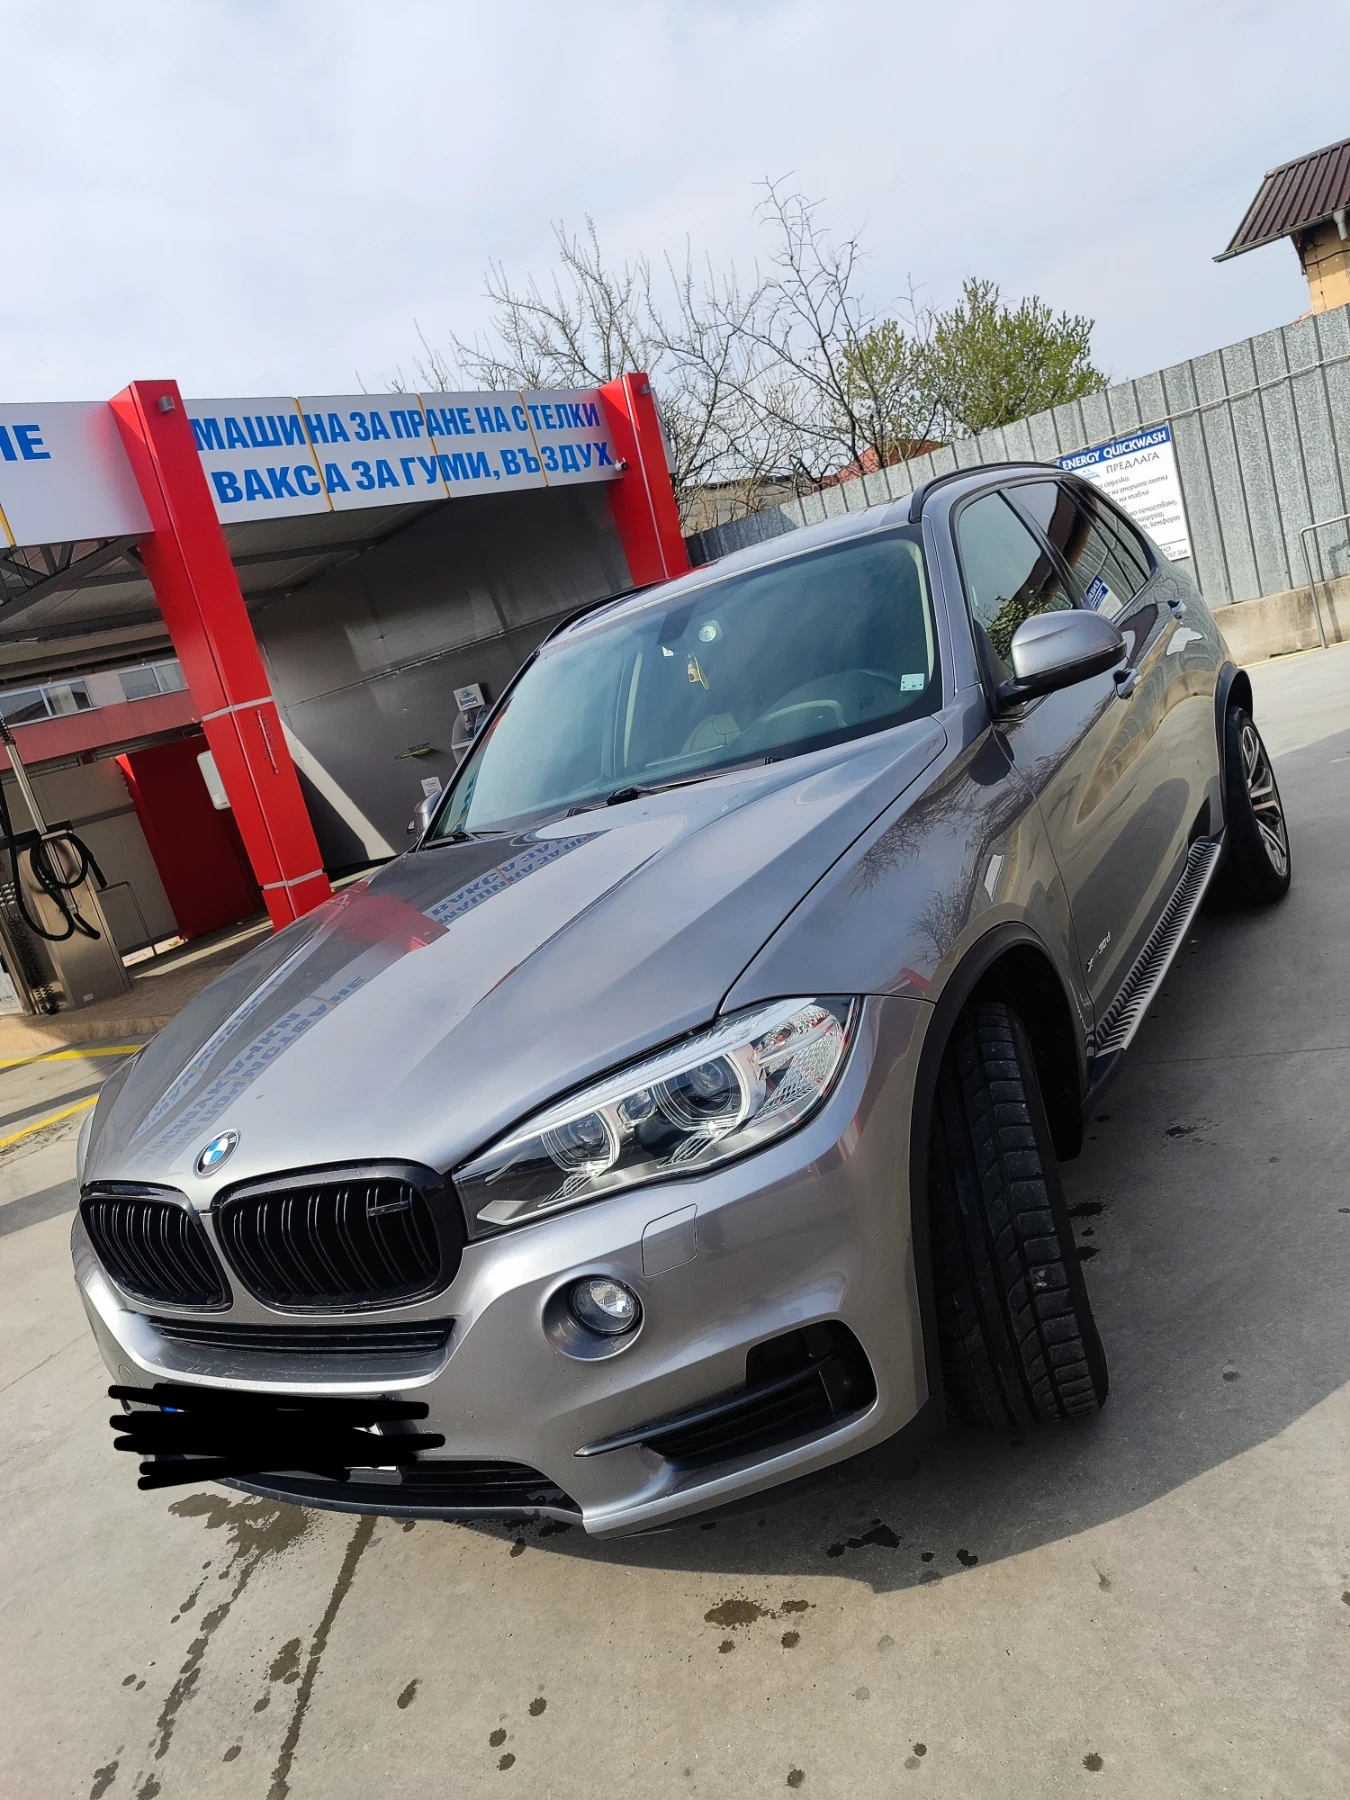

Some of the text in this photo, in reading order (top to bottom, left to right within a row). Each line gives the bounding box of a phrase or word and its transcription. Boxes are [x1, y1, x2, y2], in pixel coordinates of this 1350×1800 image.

[188, 402, 601, 451] МАШИНА ЗА ПРАНЕ НА СТЕЛКИ
[210, 441, 614, 504] ВАКСА ЗА ГУМИ, ВЪЗДУХ
[1062, 430, 1167, 471] ENERGY QUICKWASH
[1105, 451, 1160, 474] ПРЕДЛАГА
